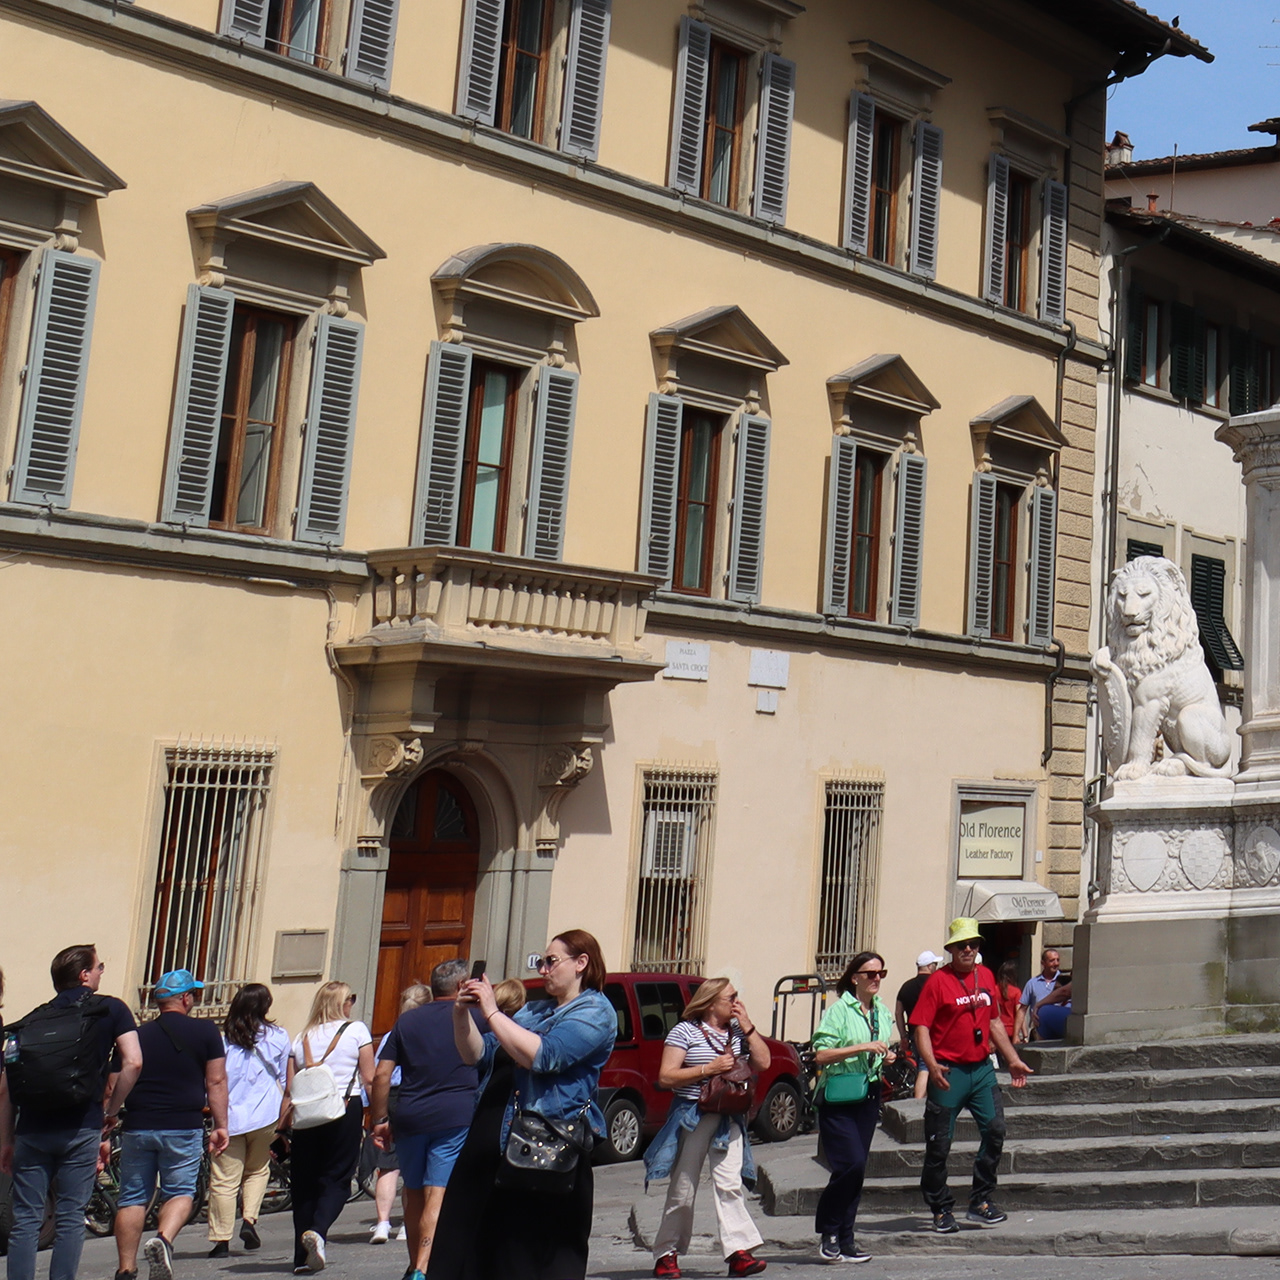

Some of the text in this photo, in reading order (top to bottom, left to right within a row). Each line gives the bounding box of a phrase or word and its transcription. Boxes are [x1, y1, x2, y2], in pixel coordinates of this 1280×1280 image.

[679, 648, 697, 656] PIAZZA
[672, 662, 708, 672] SANTA CROCE
[960, 822, 1021, 839] Old Florence
[965, 848, 1014, 861] Leather Factory
[1011, 895, 1046, 908] Old Florence
